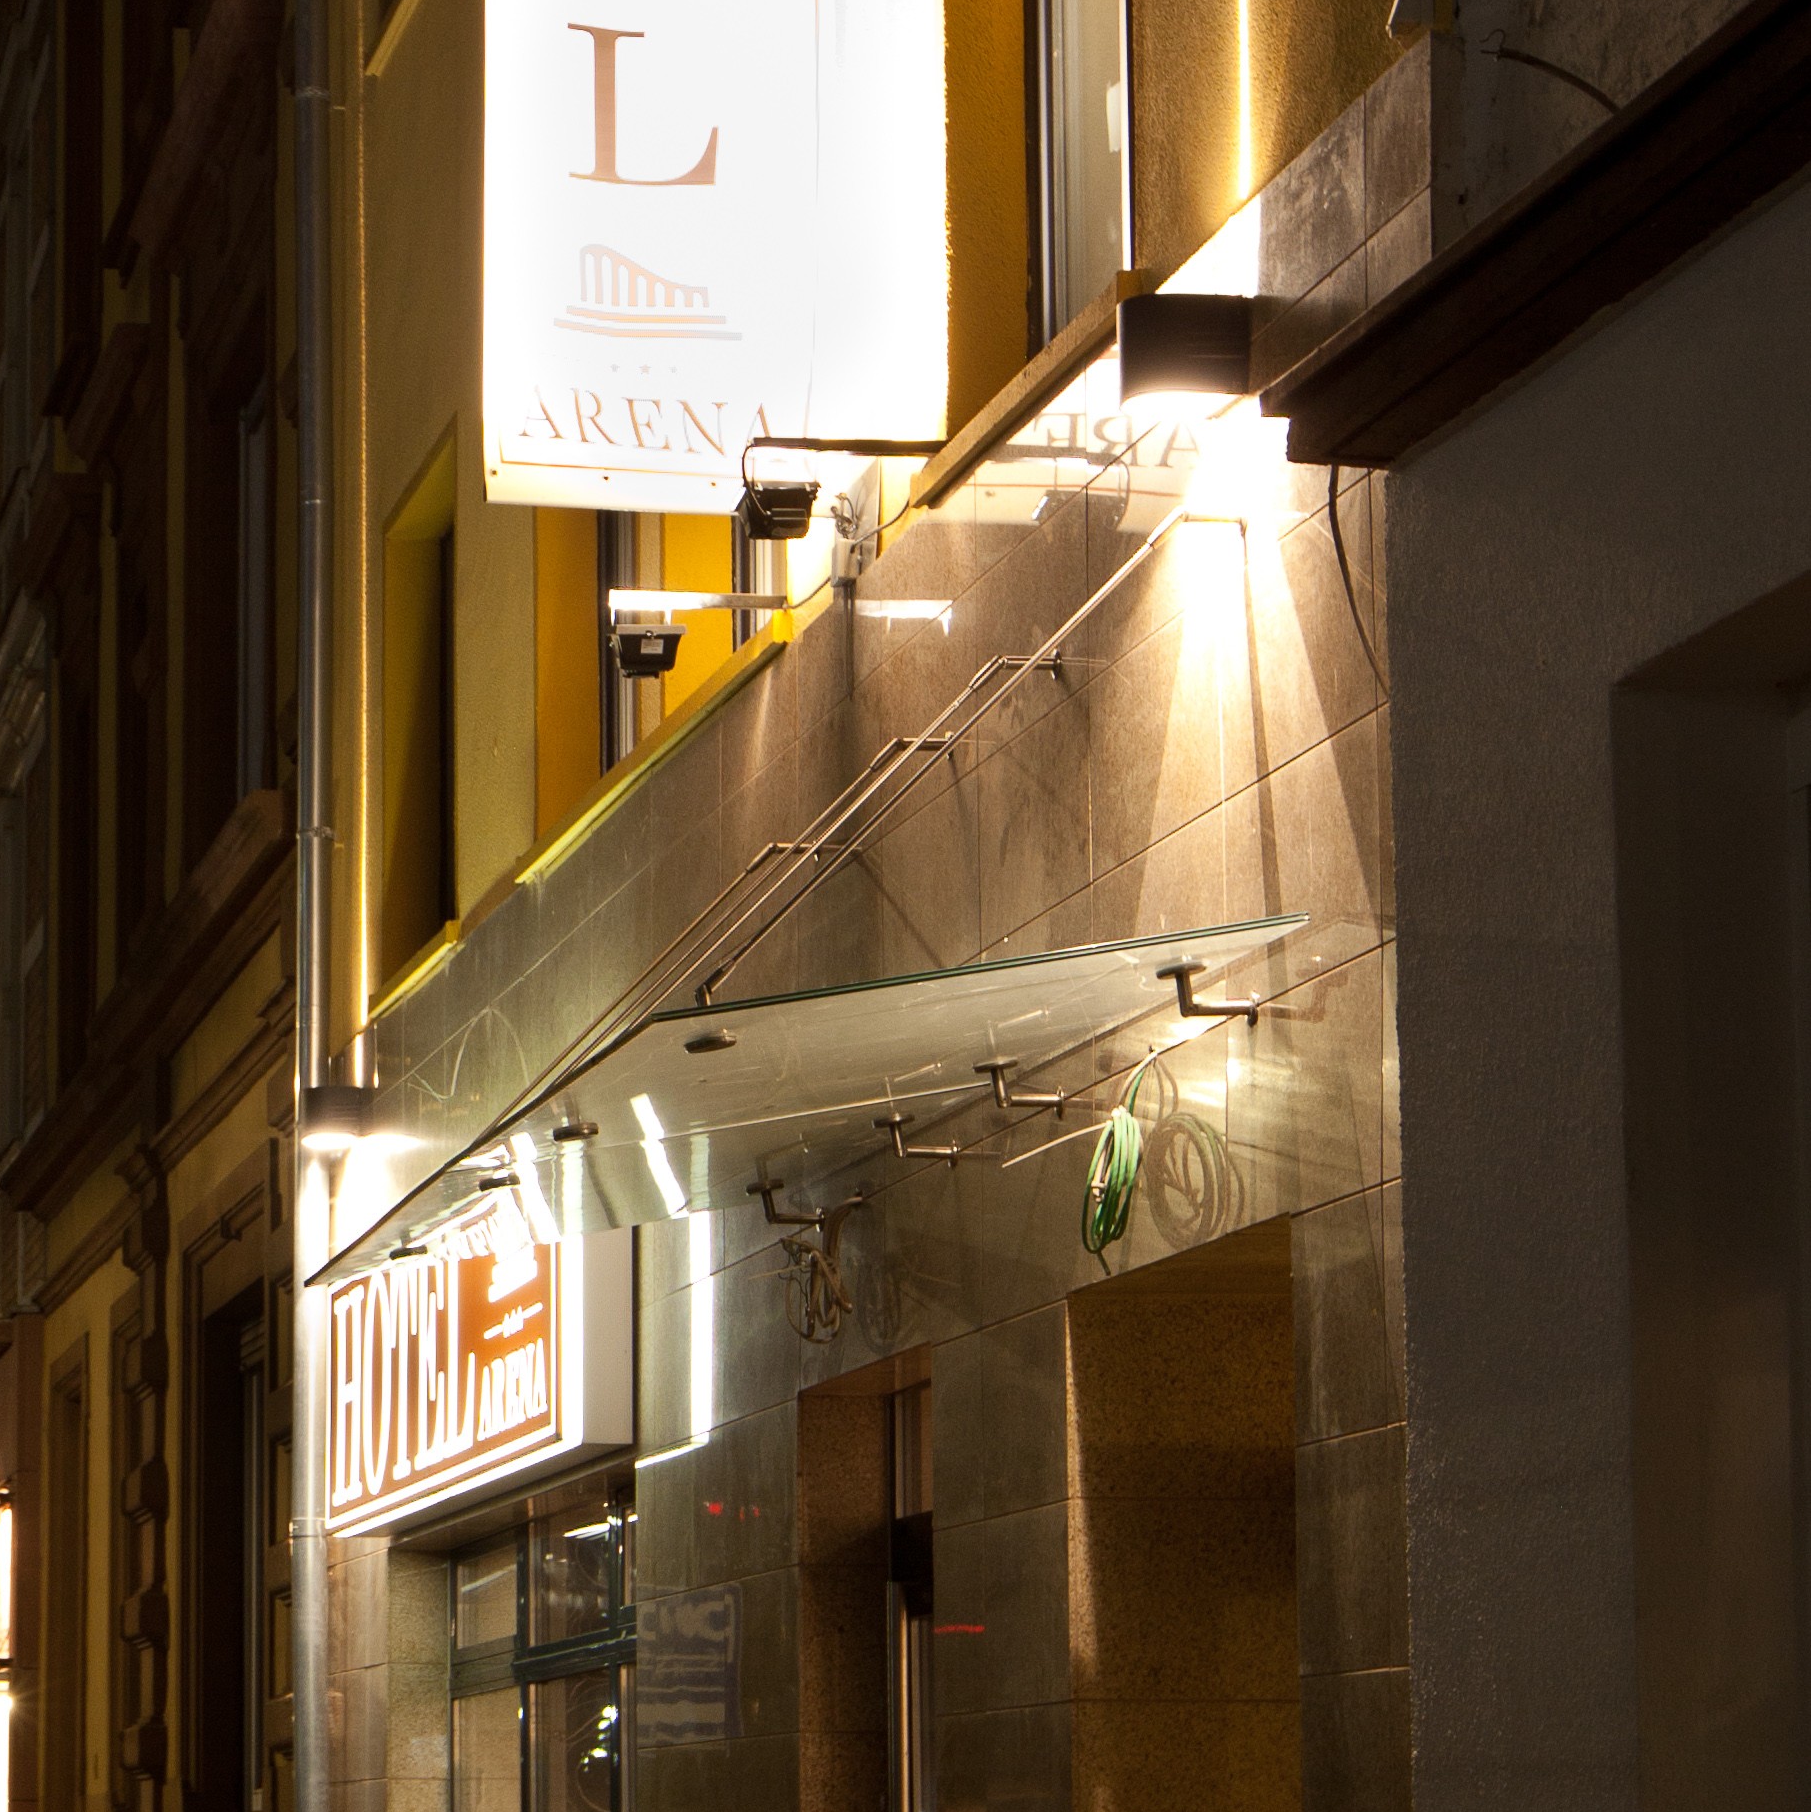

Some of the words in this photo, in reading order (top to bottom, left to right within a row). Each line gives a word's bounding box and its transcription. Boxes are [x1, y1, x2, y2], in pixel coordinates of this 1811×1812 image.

[518, 385, 788, 462] ARENA
[332, 1251, 476, 1507] HOTEL
[477, 1336, 548, 1441] ARENA
